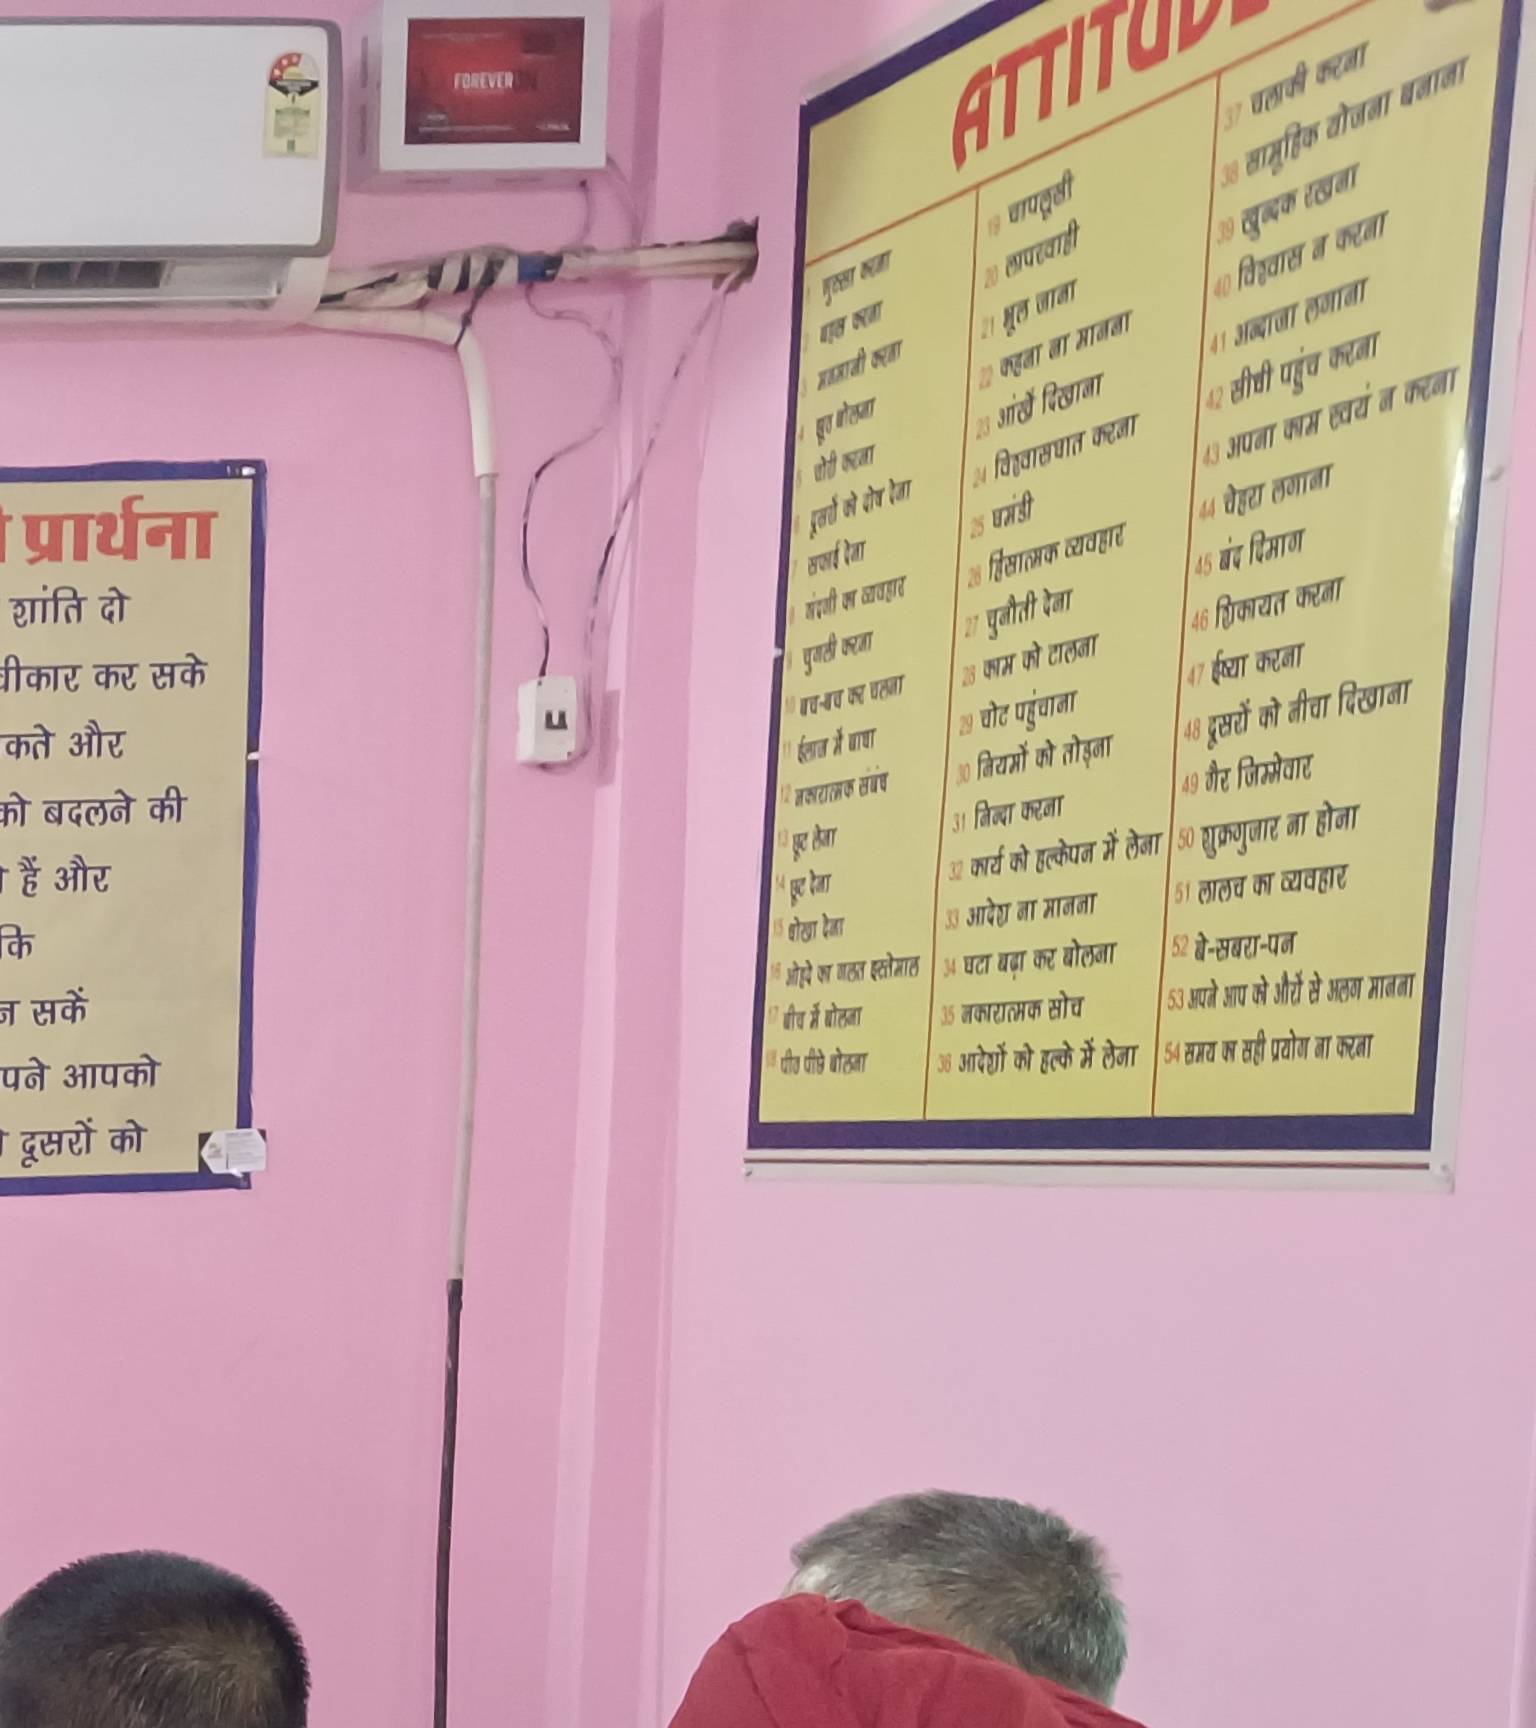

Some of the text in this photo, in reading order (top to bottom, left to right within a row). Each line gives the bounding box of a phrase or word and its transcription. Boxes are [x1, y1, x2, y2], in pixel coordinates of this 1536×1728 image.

[453, 71, 514, 89] FOREVER
[1199, 498, 1215, 521] 44
[22, 495, 219, 565] प्रार्थना
[1195, 553, 1212, 577] 45
[9, 585, 88, 628] शांति
[98, 586, 131, 624] दो
[1191, 608, 1208, 632] 46
[92, 664, 139, 691] कर
[149, 653, 208, 690] सके
[69, 719, 126, 758] और
[1184, 718, 1201, 741] 48
[1182, 772, 1198, 795] 49
[42, 789, 137, 827] बदलने
[147, 786, 188, 823] की
[1178, 827, 1195, 850] 50
[17, 856, 41, 897] हैं
[54, 854, 111, 892] और
[1175, 882, 1190, 904] 51
[1172, 934, 1189, 957] 52
[30, 986, 89, 1026] सकें
[63, 1053, 162, 1089] आपको
[20, 1117, 97, 1168] दूसरों
[109, 1119, 148, 1153] को
